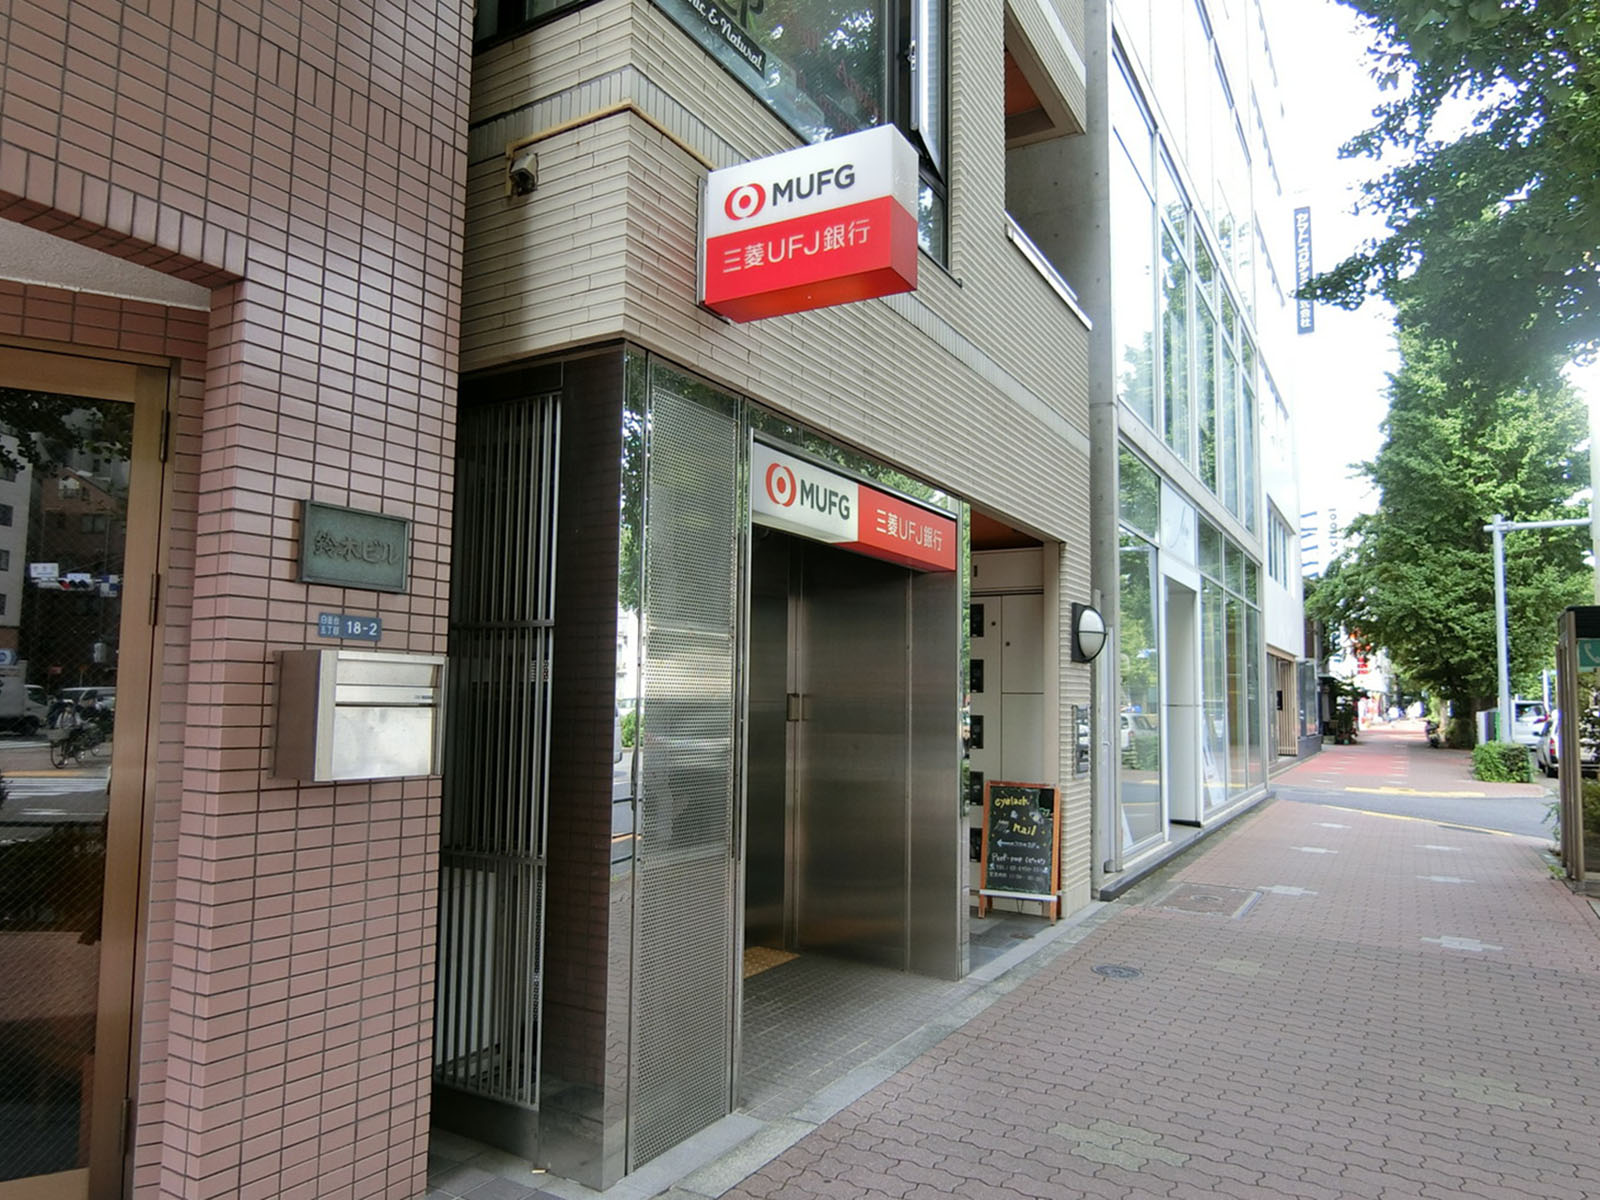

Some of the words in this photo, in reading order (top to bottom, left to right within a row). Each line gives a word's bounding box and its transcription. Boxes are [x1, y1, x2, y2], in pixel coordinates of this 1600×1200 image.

[708, 8, 719, 25] &
[720, 18, 762, 71] Natural
[772, 164, 856, 207] MUFG
[722, 218, 870, 274] 三菱UFJ銀行
[801, 479, 850, 520] MUFG
[313, 530, 399, 565] 鈴木ビル
[876, 509, 943, 551] 三菱UFJ銀行
[346, 620, 378, 636] 18-2
